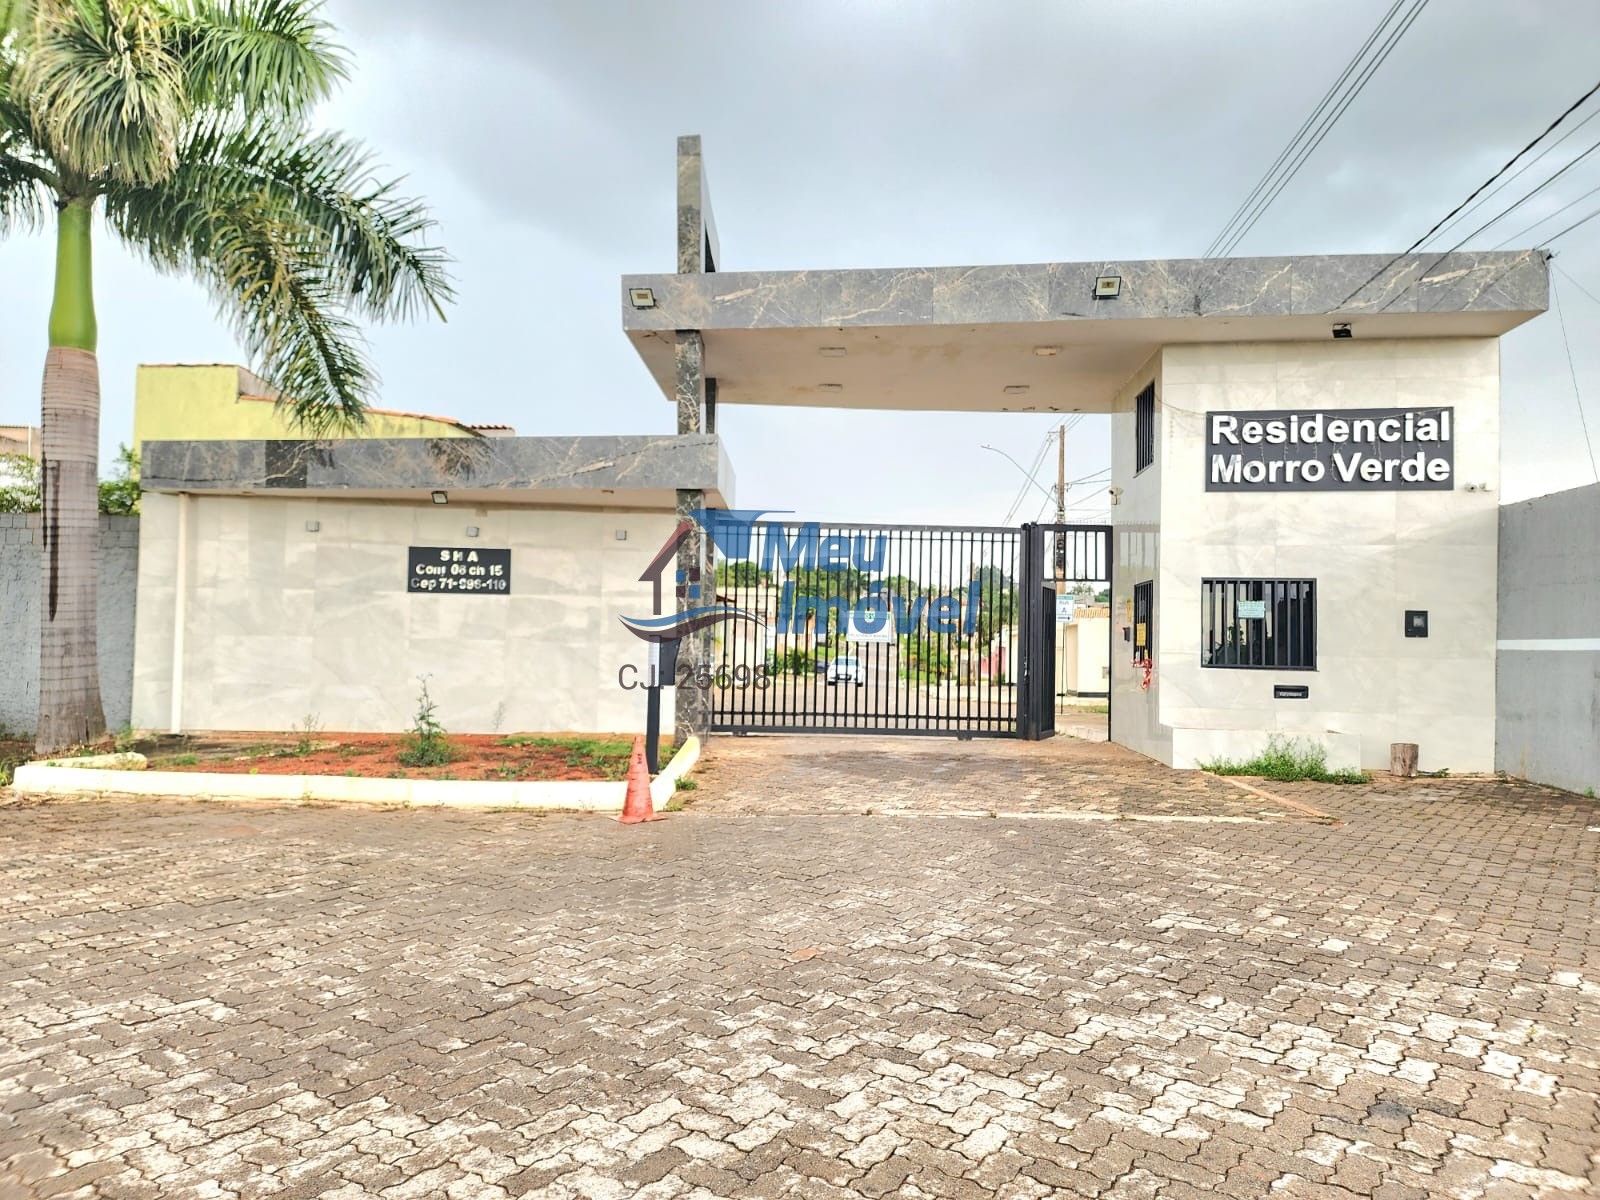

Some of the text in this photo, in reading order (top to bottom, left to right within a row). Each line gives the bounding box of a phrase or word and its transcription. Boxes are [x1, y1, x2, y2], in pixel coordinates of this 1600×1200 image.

[1212, 411, 1450, 445] Residencial
[1211, 452, 1450, 484] Morro Verde
[468, 564, 486, 576] ch
[489, 564, 503, 577] 15
[411, 577, 437, 591] Cep
